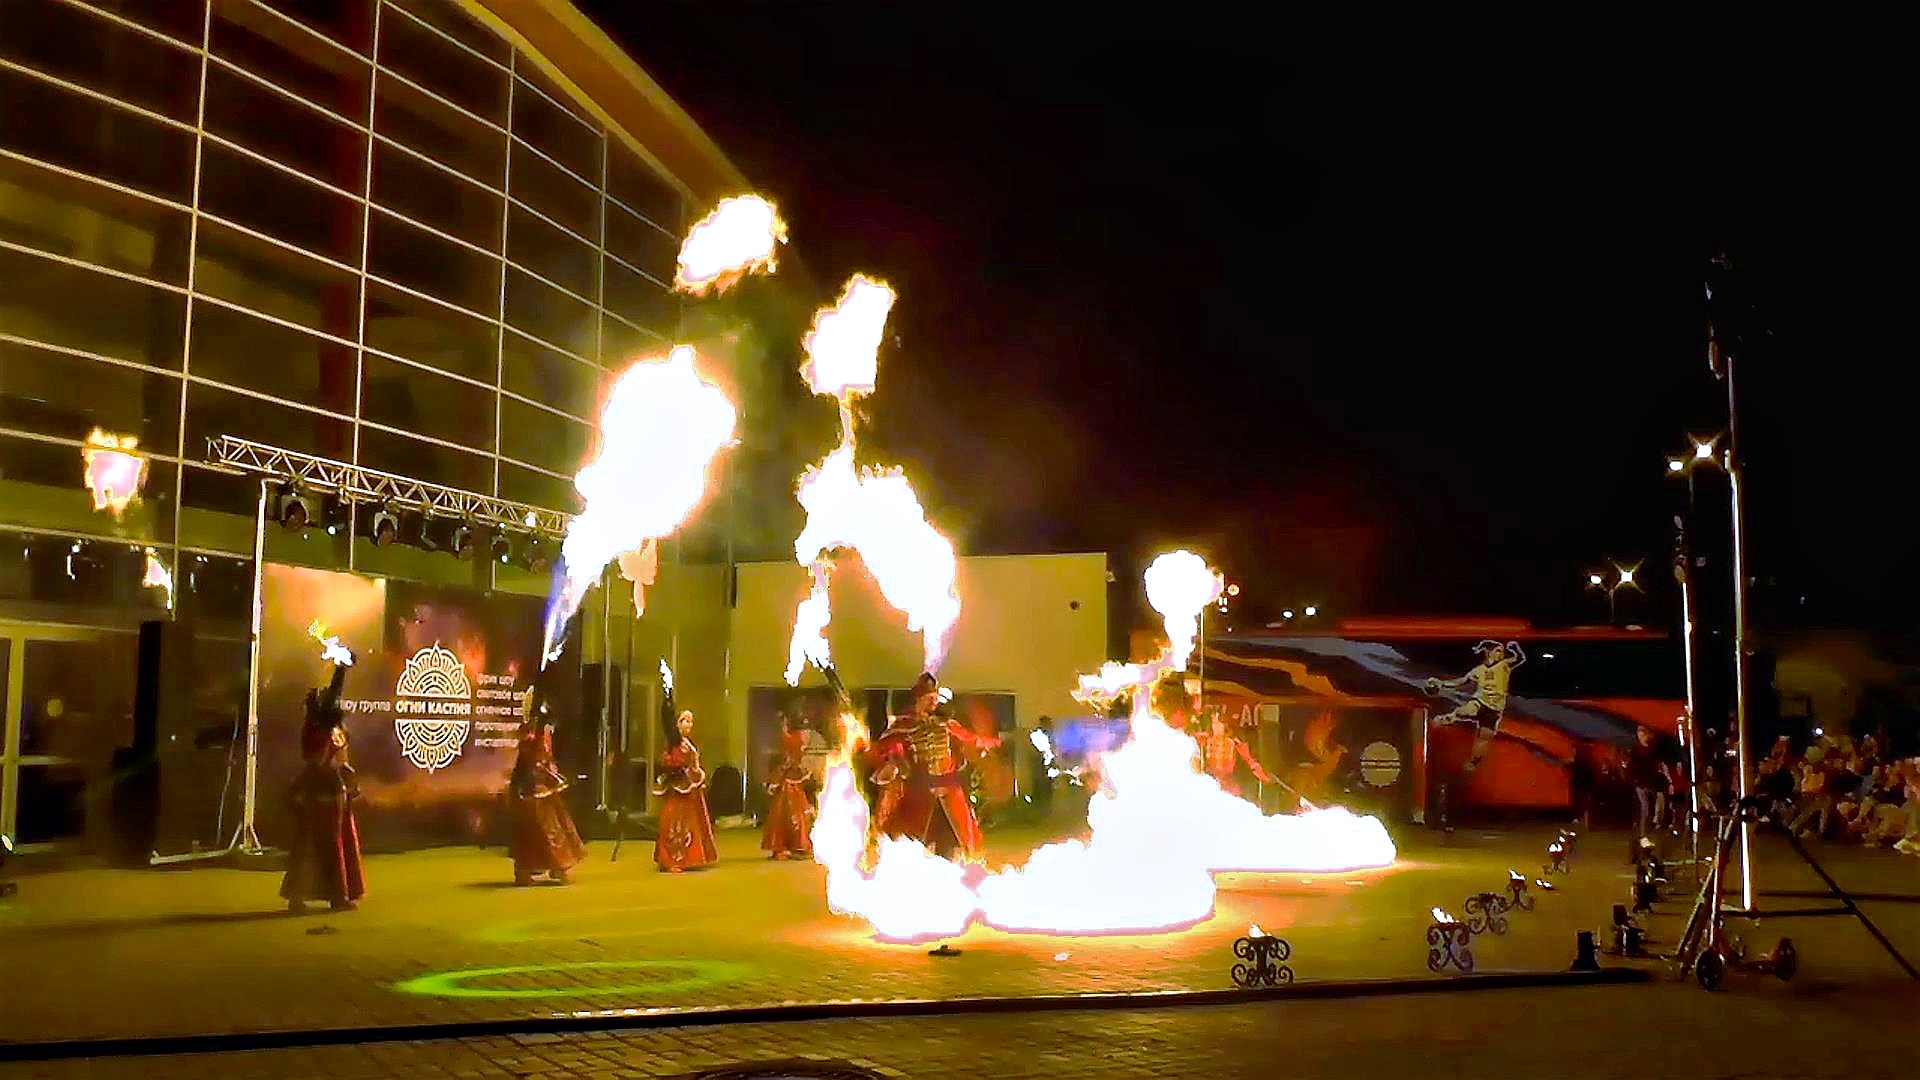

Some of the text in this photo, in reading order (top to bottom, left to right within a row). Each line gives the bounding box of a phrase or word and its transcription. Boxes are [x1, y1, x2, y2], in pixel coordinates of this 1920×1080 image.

[359, 700, 391, 713] группа
[395, 700, 471, 715] ОГНИ КАСПИЯ
